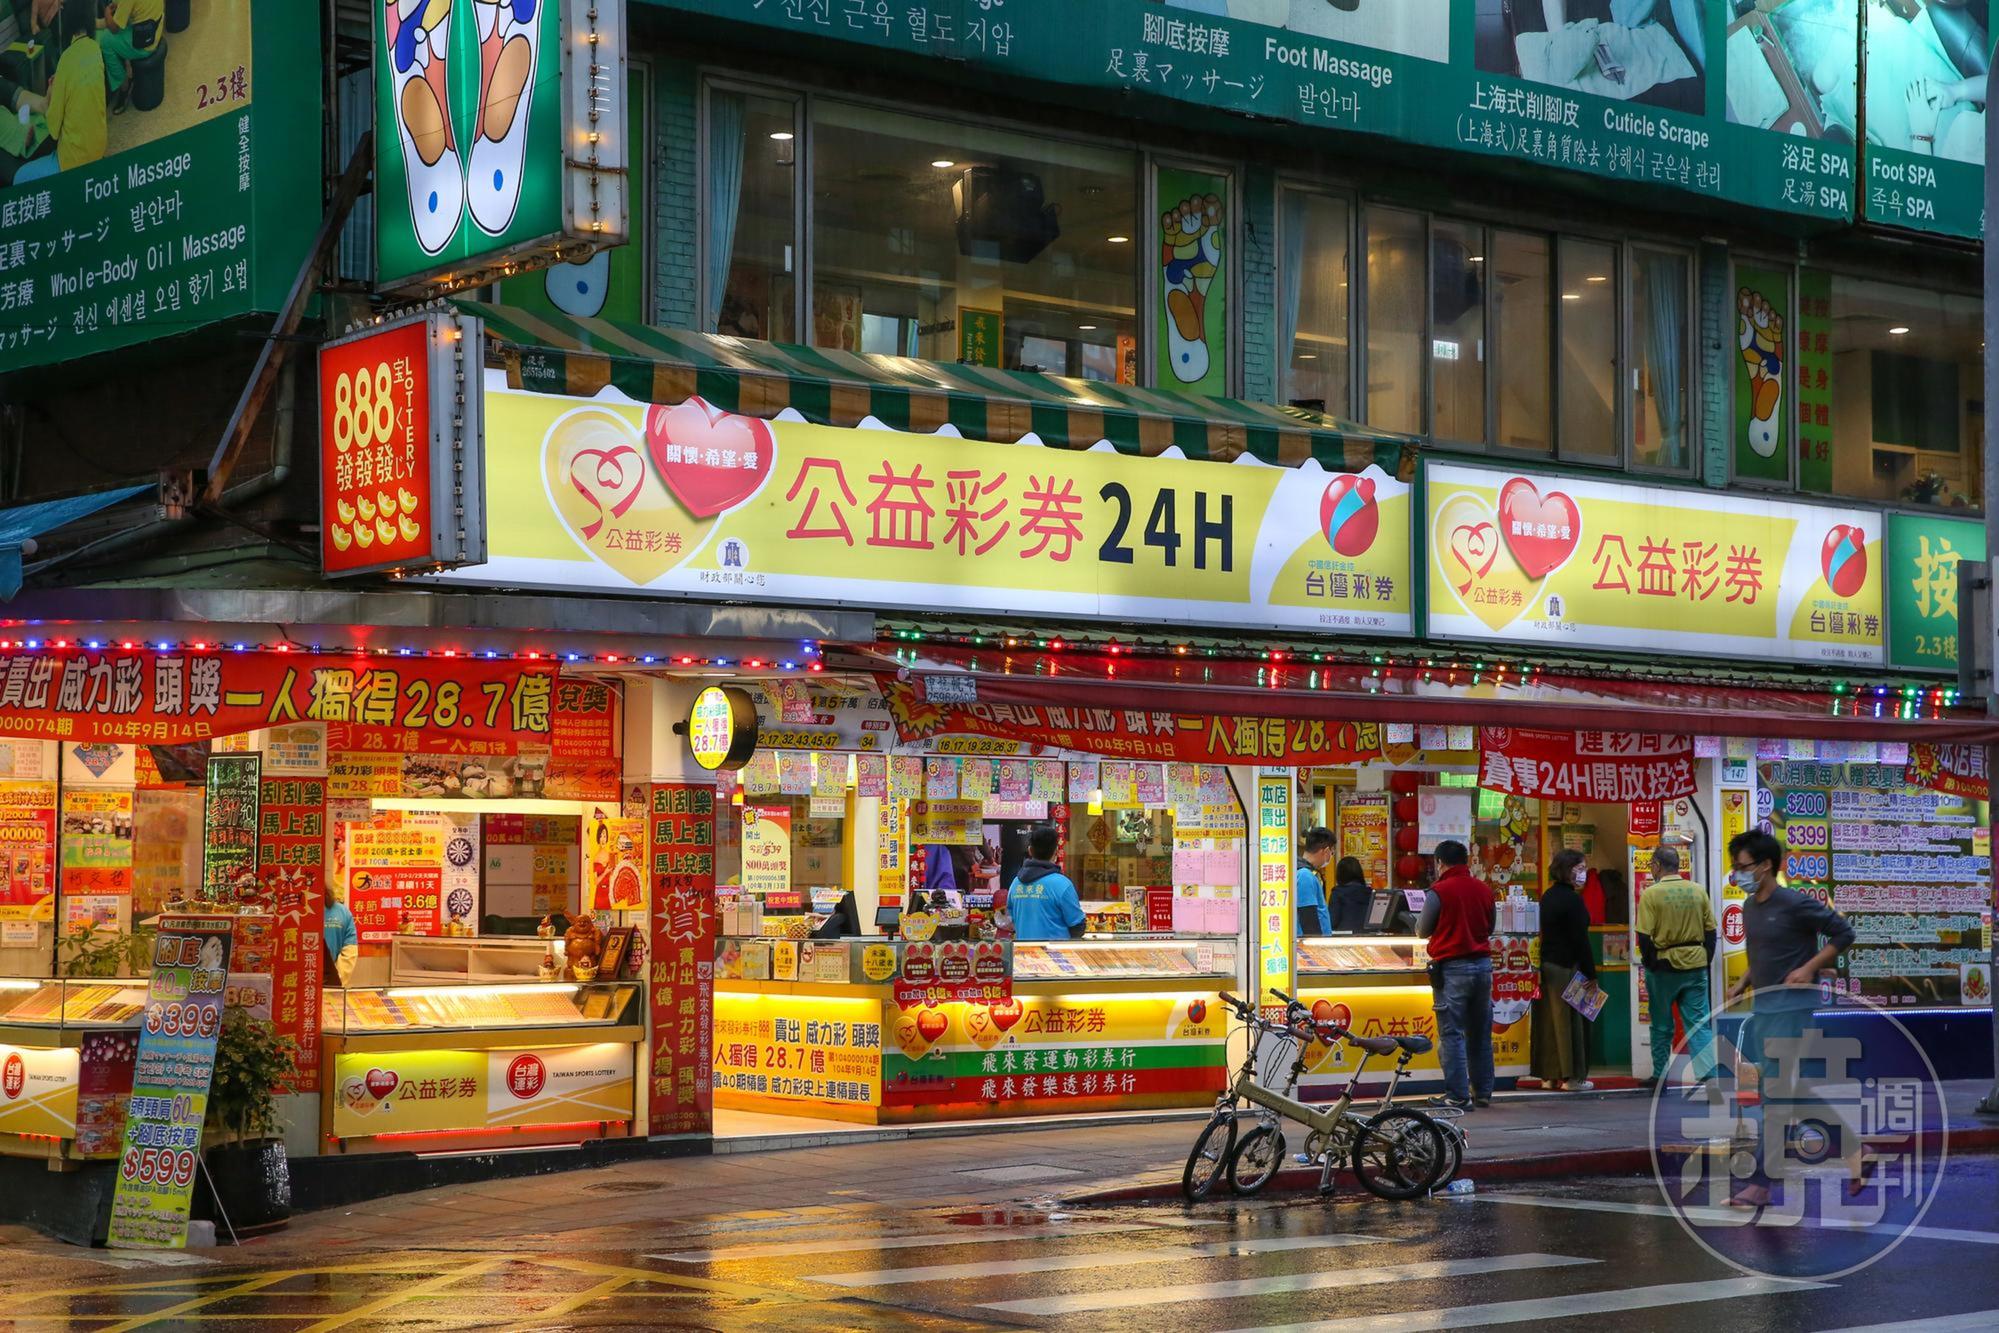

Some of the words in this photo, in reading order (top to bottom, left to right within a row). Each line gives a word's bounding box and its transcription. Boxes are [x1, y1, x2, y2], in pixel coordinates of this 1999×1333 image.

[906, 7, 955, 42] 혈도
[965, 18, 1014, 56] 지압
[1142, 12, 1230, 57] 腳底按摩
[1105, 48, 1265, 99] 足裏マッサージ
[1265, 37, 1307, 68] Foot
[1313, 47, 1392, 88] Massage
[196, 66, 248, 110] 2.3樓
[1298, 82, 1361, 122] 발안마
[1469, 82, 1580, 128] 上海式削腳皮
[1604, 108, 1655, 137] Cuticle
[1659, 118, 1709, 150] Scrape
[1605, 144, 1645, 177] 상해식
[1650, 151, 1691, 184] 굳은살
[1696, 161, 1721, 191] 관리
[1782, 143, 1816, 174] 浴足
[1821, 153, 1849, 178] SPA
[1872, 157, 1904, 182] Foot
[1908, 164, 1937, 188] SPA
[85, 174, 119, 203] Foot
[128, 152, 191, 189] Massage
[1781, 178, 1816, 207] 足湯
[1820, 186, 1848, 212] SPA
[1872, 187, 1903, 217] 족욕
[1906, 197, 1935, 220] SPA
[131, 190, 183, 233] 발안마
[51, 254, 139, 298] Whole-Body
[147, 241, 172, 271] Oil
[183, 224, 246, 261] Massage
[73, 302, 98, 335] 전신
[153, 279, 181, 312] 오일
[189, 269, 214, 304] 향기
[222, 259, 247, 292] 요법
[333, 362, 395, 453] 888
[404, 356, 416, 479] LOTTERY
[335, 443, 395, 492] 發發發
[786, 456, 1084, 562] 公益彩券
[1099, 481, 1234, 573] 24H
[605, 527, 683, 555] 公益彩券
[1591, 532, 1765, 606] 公益彩券
[1306, 570, 1394, 601] 台灣彩券
[1473, 586, 1523, 608] 公益彩券
[1810, 609, 1879, 637] 台灣彩券
[57, 656, 144, 715] 威力彩
[153, 656, 222, 716] 頭獎
[92, 720, 213, 739] 104年9月14日
[362, 730, 419, 752] 28.7億
[861, 737, 874, 747] 34
[1086, 737, 1176, 758] 104年9月14日
[1481, 750, 1695, 802] 賽事24H開放投注
[1731, 768, 1745, 780] 147
[261, 781, 323, 807] 刮刮樂
[653, 789, 713, 816] 刮刮樂
[1261, 785, 1288, 805] 本店
[1757, 791, 1772, 805] 20
[1787, 793, 1826, 815] $200
[261, 812, 323, 837] 馬上刮
[1261, 807, 1288, 828] 賣出
[654, 820, 713, 846] 馬上刮
[1787, 825, 1827, 846] $399
[260, 844, 322, 866] 馬上兌獎
[654, 852, 713, 876] 馬上兌獎
[1787, 856, 1828, 878] $499
[1262, 864, 1287, 883] 頭獎
[403, 895, 438, 909] 3.6億
[1261, 889, 1289, 908] 28.7
[281, 971, 299, 1024] 威力彩
[146, 1003, 218, 1038] $399
[678, 996, 696, 1055] 威力彩
[774, 1018, 801, 1044] 賣出
[805, 1020, 848, 1047] 威力彩
[851, 1021, 881, 1049] 頭獎
[1024, 1008, 1107, 1035] 公益彩券
[514, 1063, 539, 1078] 台灣
[552, 1070, 574, 1079] TAIWAN
[575, 1069, 594, 1078] SPORTS
[594, 1068, 616, 1077] LOTTERY
[765, 1045, 826, 1075] 28.7億
[832, 1063, 878, 1078] 104年9月14日
[981, 1048, 1137, 1073] 飛來發運動彩券行
[399, 1077, 478, 1102] 公益彩券
[514, 1076, 538, 1092] 運彩
[980, 1072, 1138, 1100] 飛來發樂透彩券行
[130, 1096, 171, 1121] 頭頸肩
[122, 1146, 197, 1187] $599
